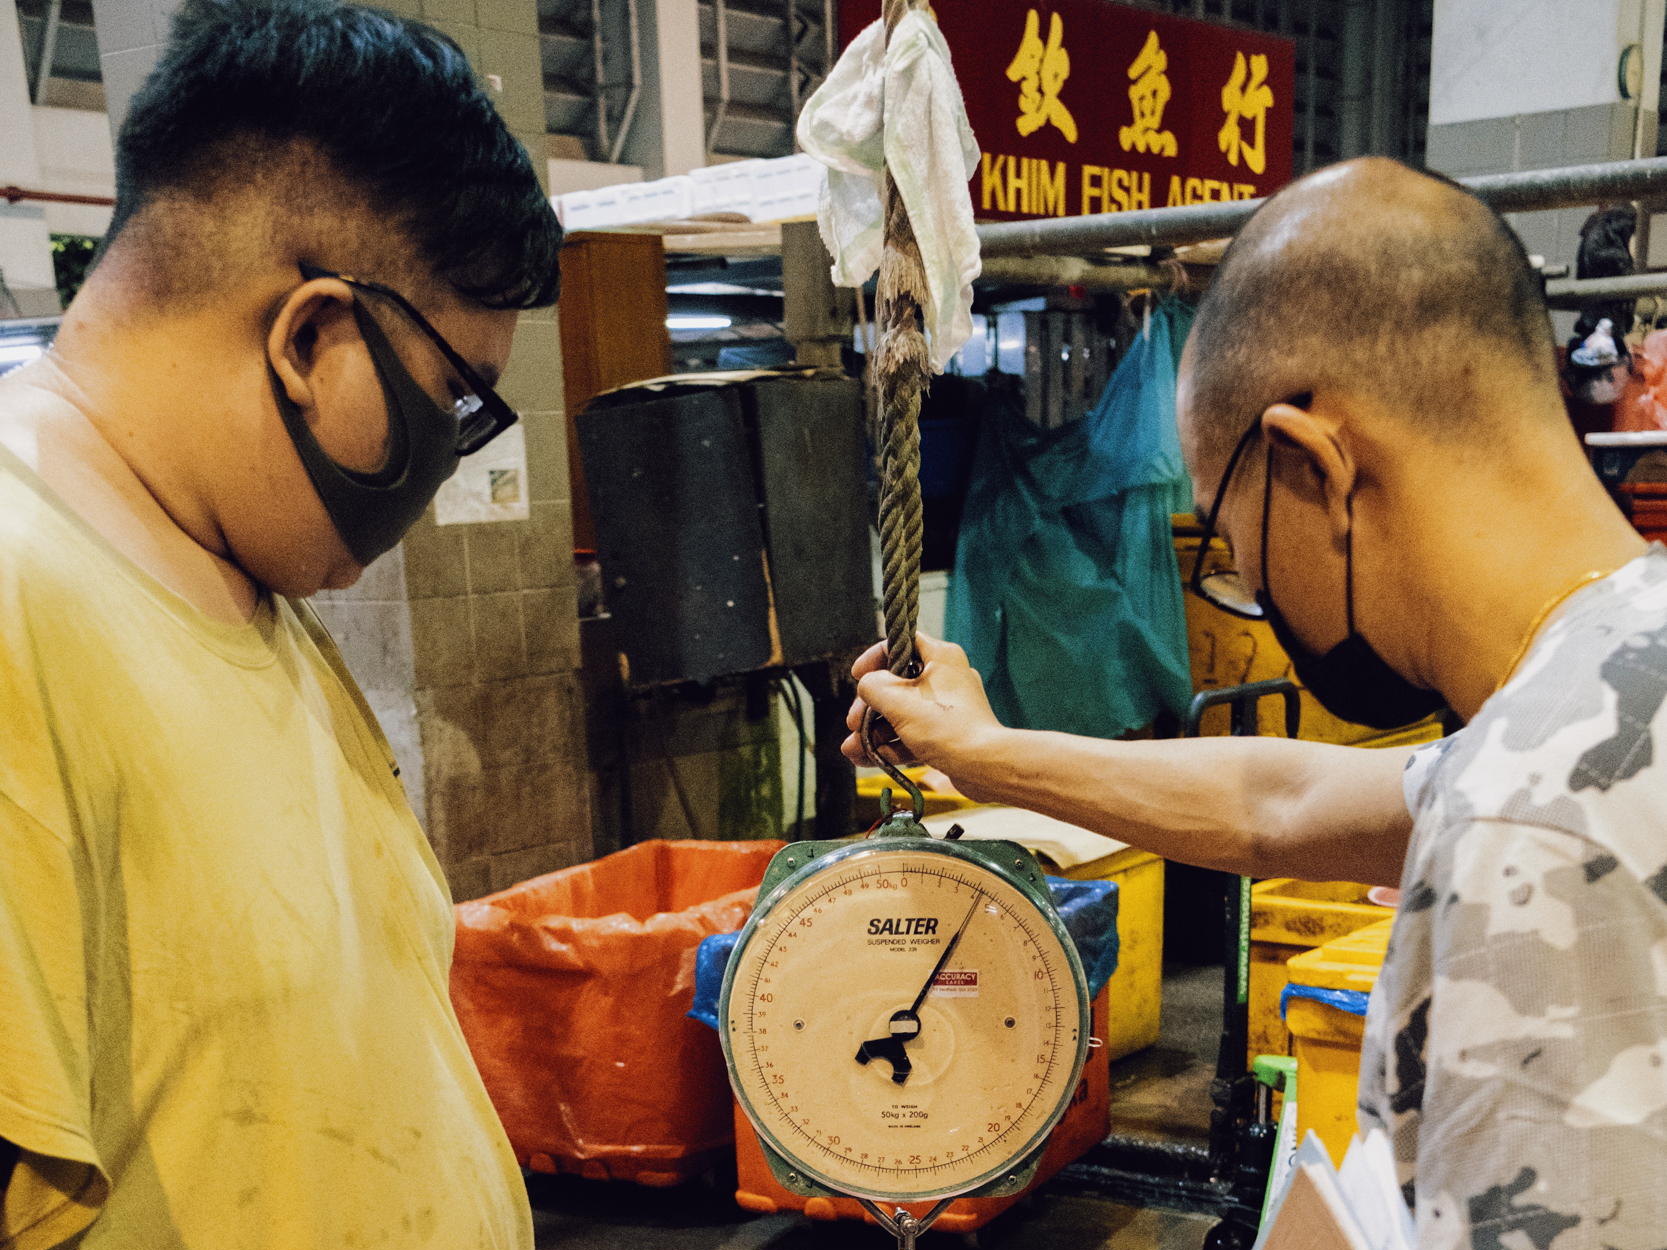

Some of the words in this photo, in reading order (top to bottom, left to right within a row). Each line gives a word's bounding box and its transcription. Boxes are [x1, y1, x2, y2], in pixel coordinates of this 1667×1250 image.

[981, 151, 1067, 218] KHIM
[1081, 163, 1152, 215] FISH
[876, 879, 898, 890] 50kg
[799, 918, 813, 928] 45
[867, 917, 939, 935] SALTER
[1034, 971, 1044, 980] 10
[759, 993, 773, 1003] 40
[1037, 1054, 1046, 1064] 15
[772, 1074, 785, 1085] 35
[881, 1110, 900, 1119] 50kg
[909, 1110, 928, 1119] 200g
[987, 1122, 1001, 1133] 20
[828, 1135, 841, 1145] 30
[909, 1155, 921, 1165] 25
